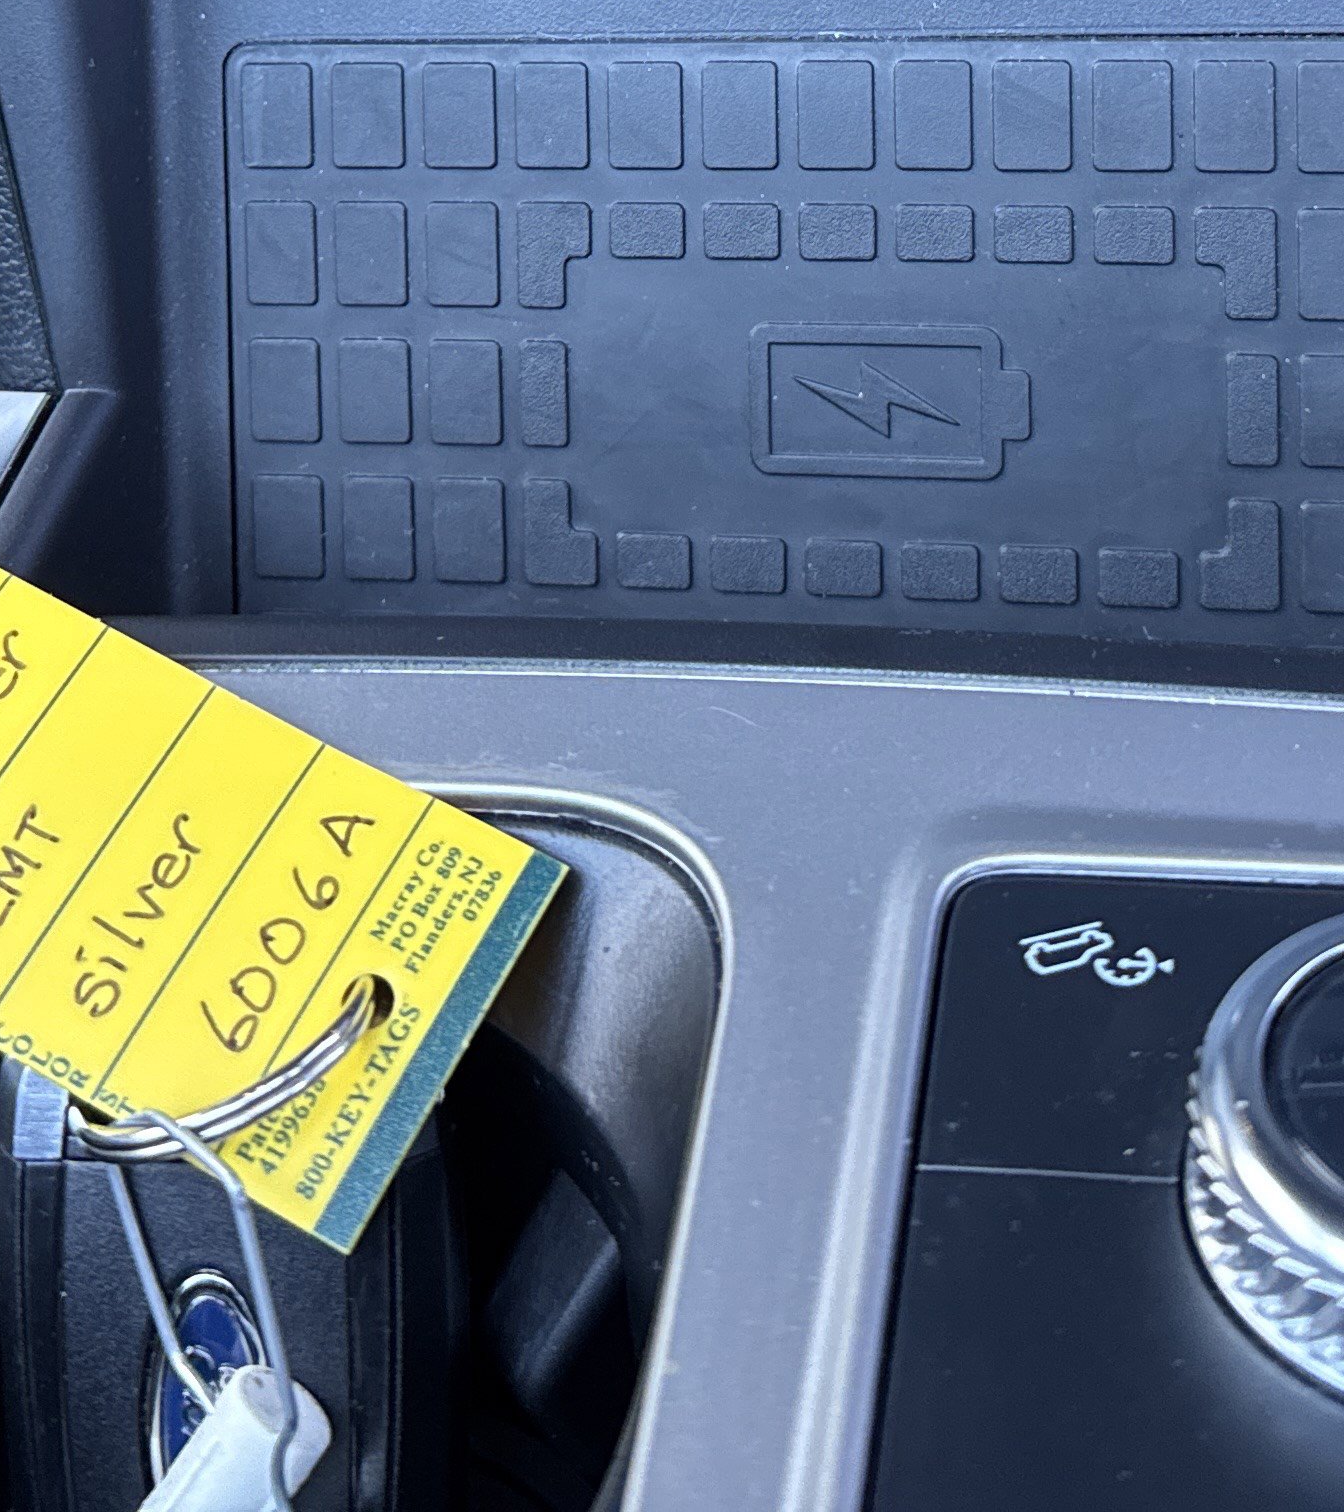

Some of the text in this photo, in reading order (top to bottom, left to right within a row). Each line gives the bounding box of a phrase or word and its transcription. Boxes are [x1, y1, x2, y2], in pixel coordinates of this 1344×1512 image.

[73, 811, 202, 1018] Silver
[368, 840, 446, 942] Macray Co.
[389, 846, 463, 953] PO Box 809
[404, 855, 484, 975] Flanders, NJ
[462, 870, 503, 922] 07836
